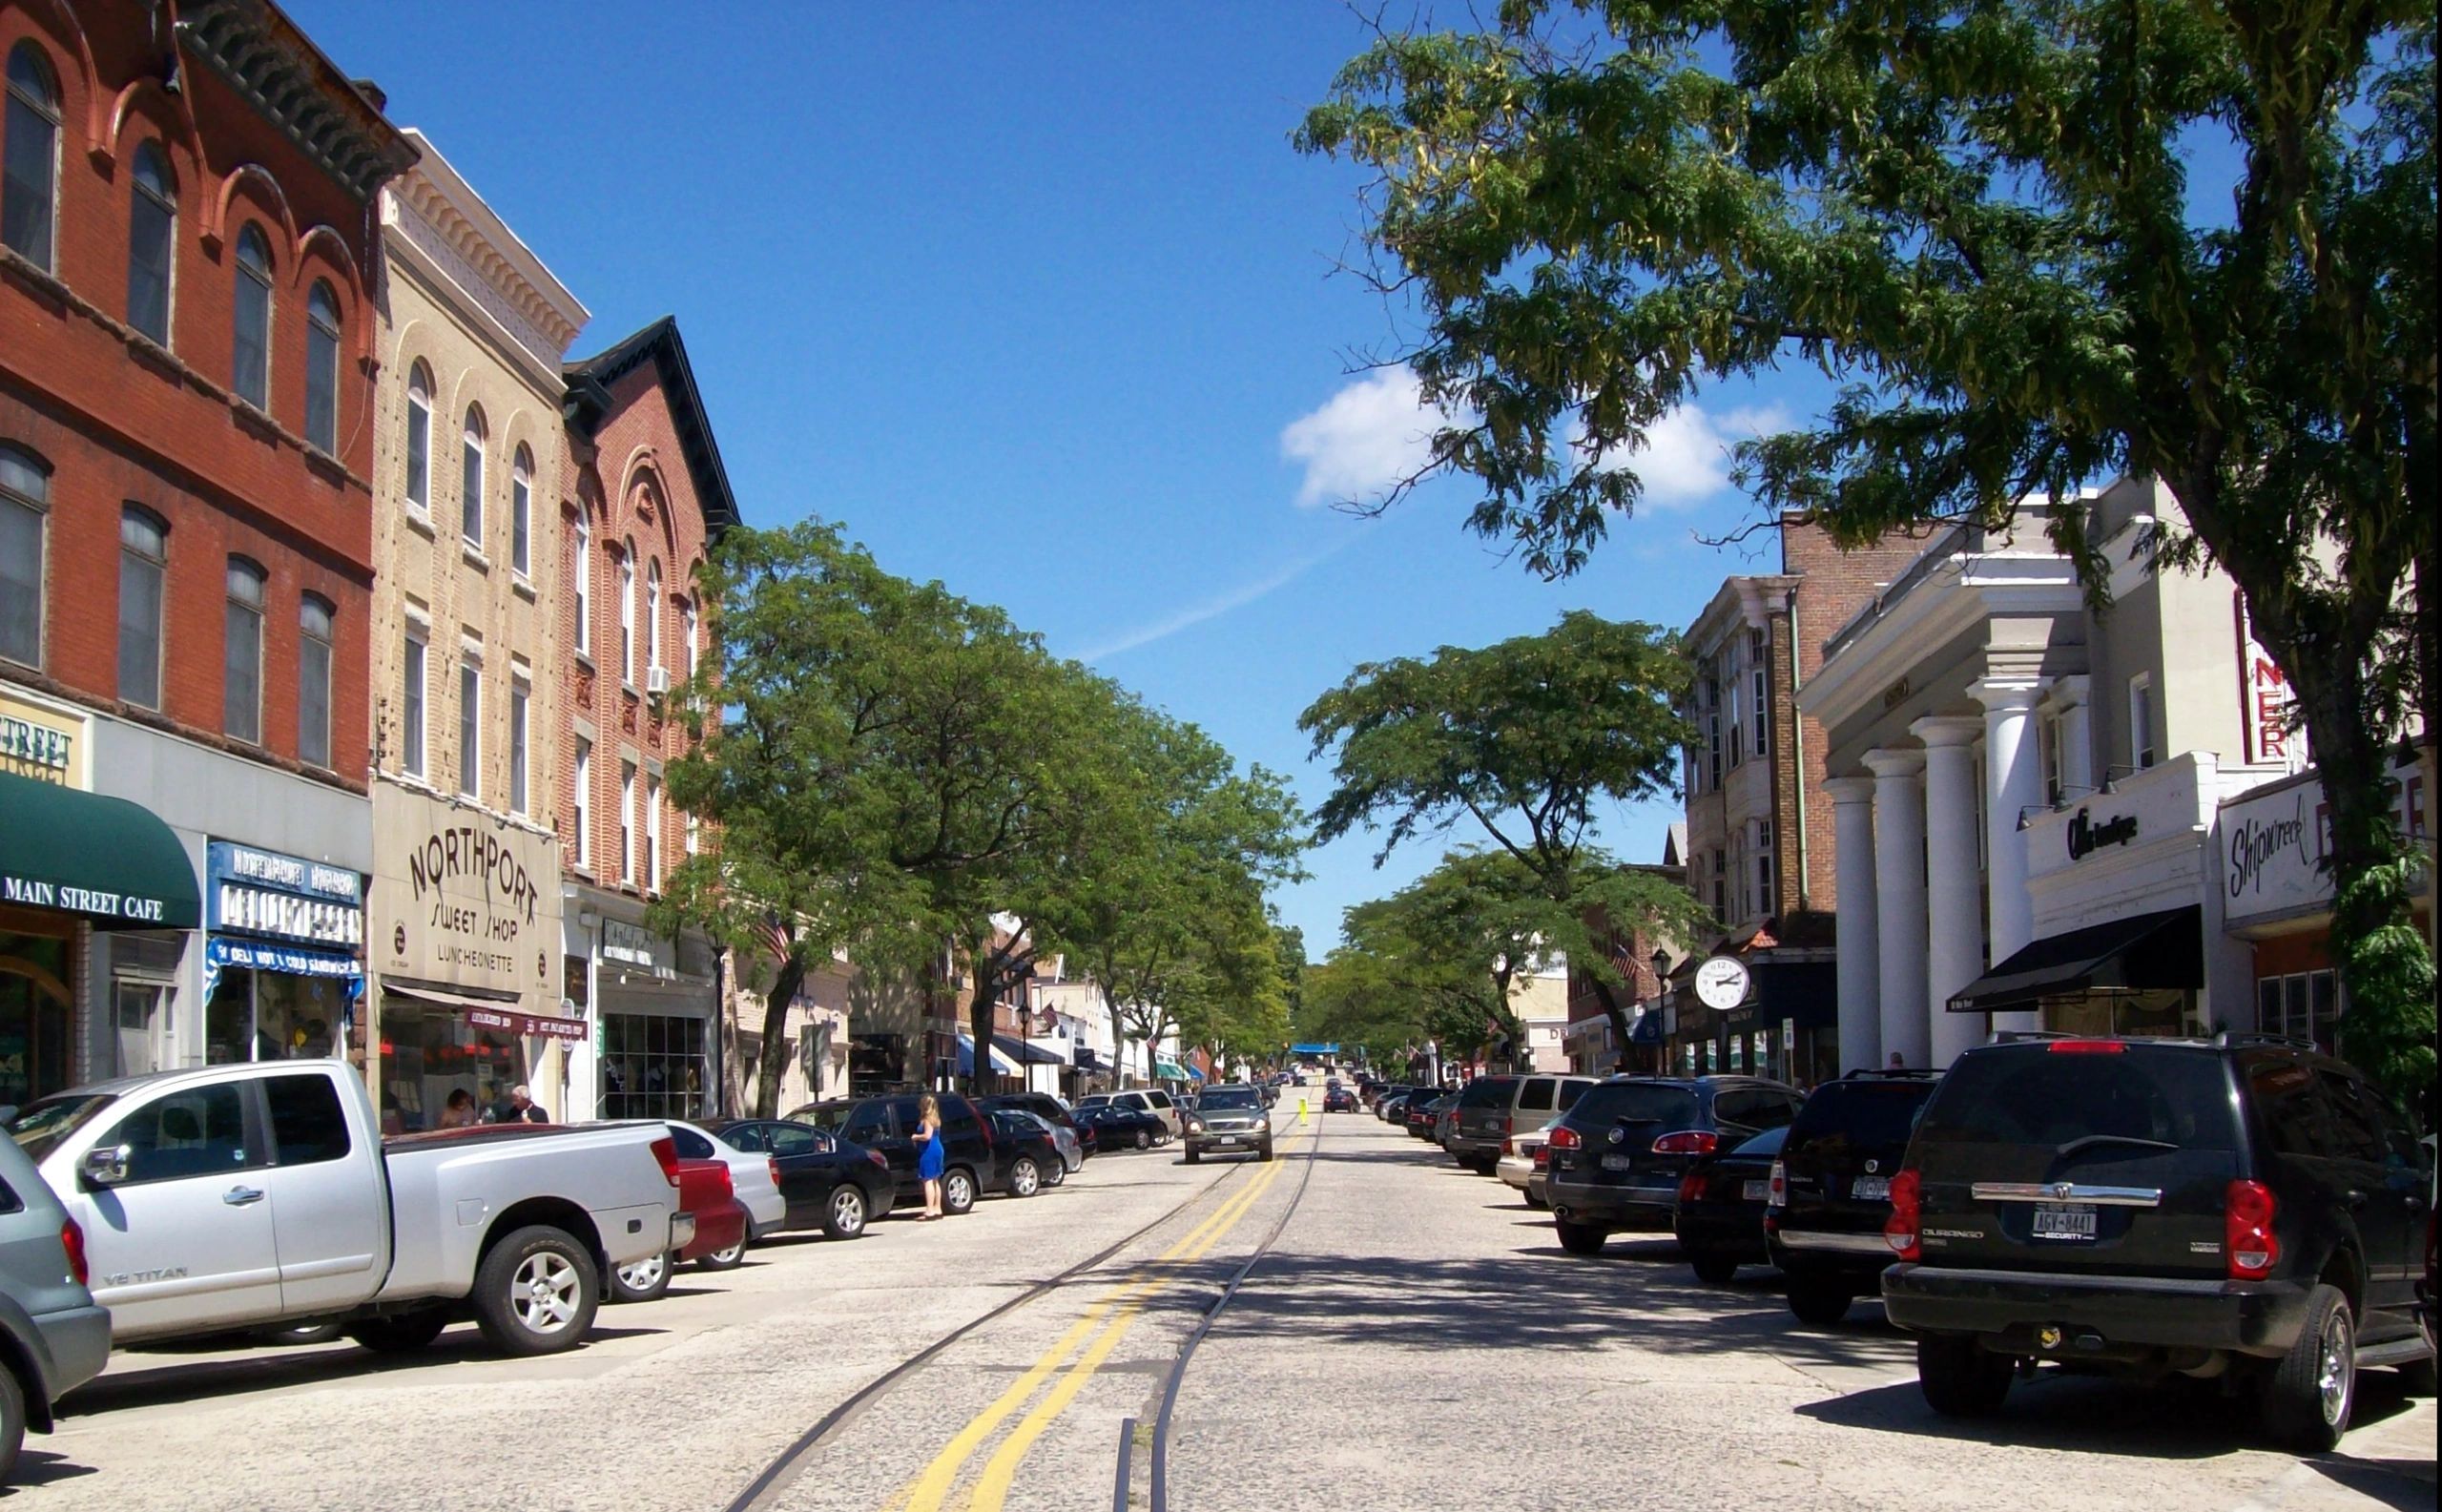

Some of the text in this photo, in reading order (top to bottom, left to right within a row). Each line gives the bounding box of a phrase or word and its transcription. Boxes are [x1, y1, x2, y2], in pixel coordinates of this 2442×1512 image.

[2254, 657, 2287, 757] NER
[0, 718, 72, 765] TREET
[2230, 794, 2307, 898] Shipwreck
[5, 877, 163, 921] MAIN STREET CAFE
[410, 827, 538, 931] NORTHPORT
[431, 903, 518, 943] SWEET SHOP
[231, 947, 253, 963] DELI
[256, 950, 275, 965] HOT
[286, 956, 307, 971] COLD
[438, 944, 513, 973] LUNCHEONETTE
[1922, 1228, 1984, 1239] DURANGO
[2045, 1232, 2082, 1240] SECURITY
[134, 1267, 188, 1282] TITAN
